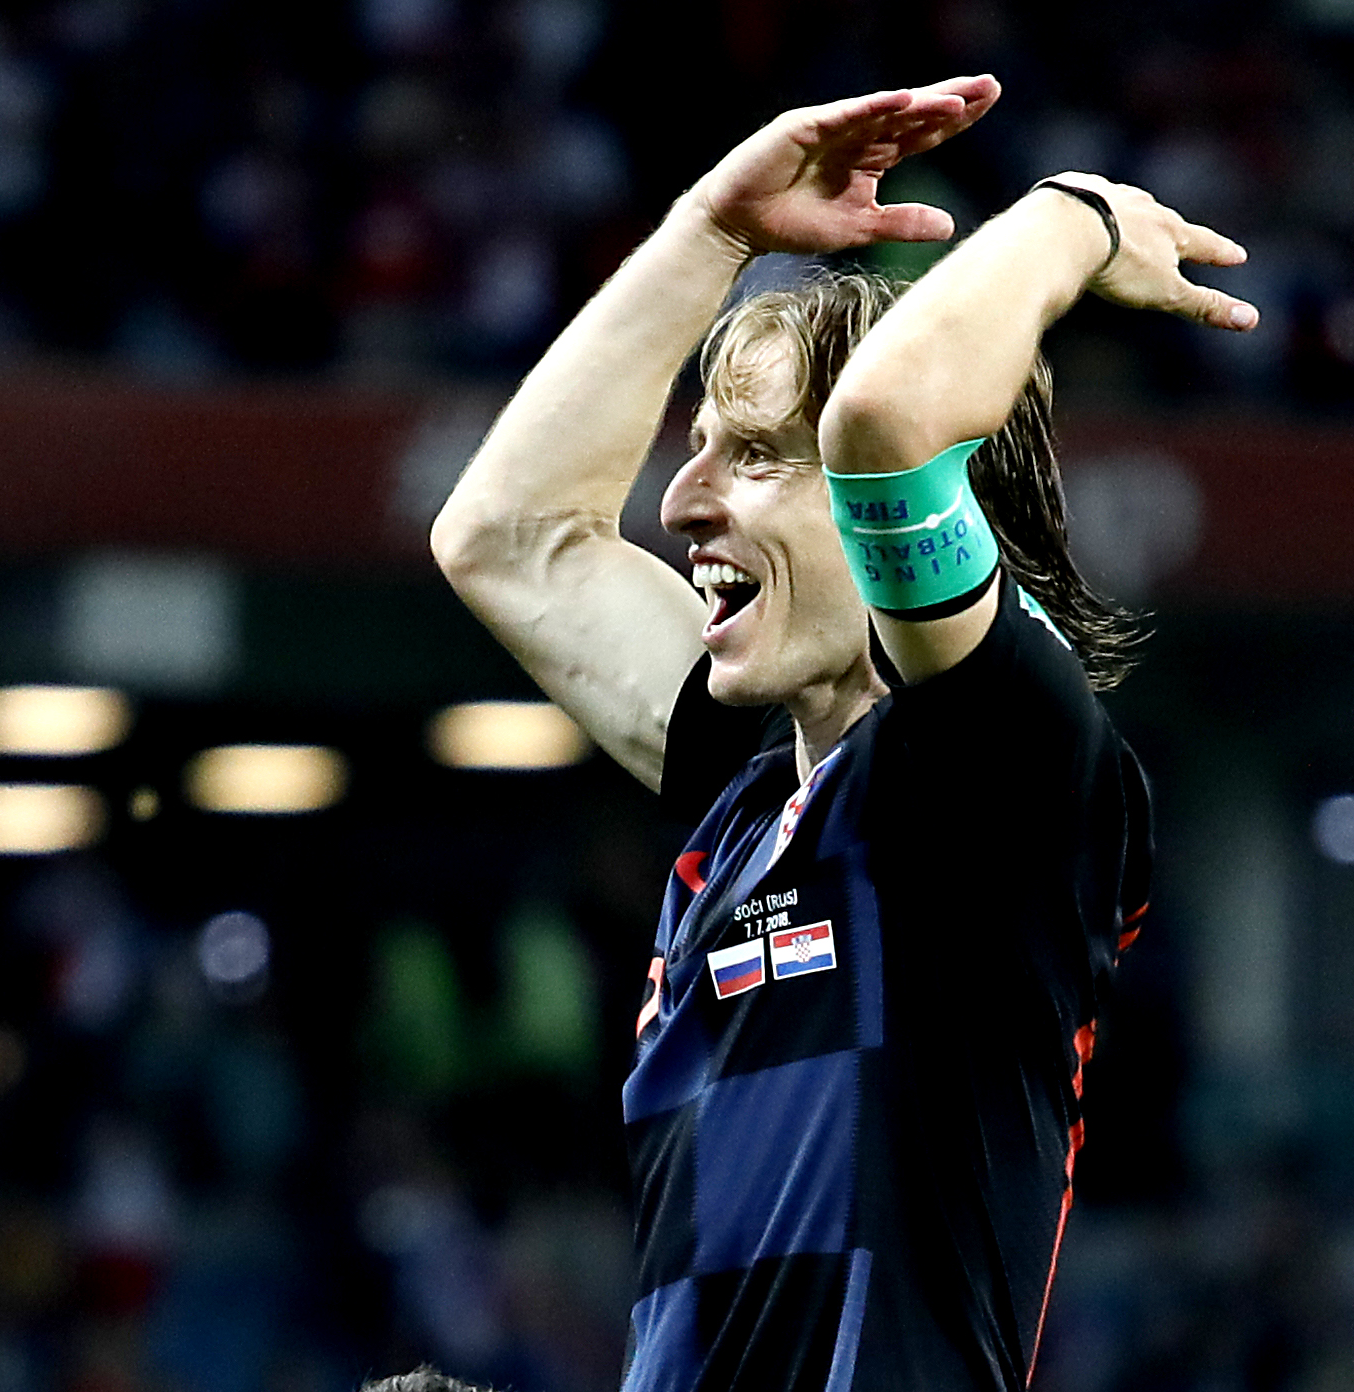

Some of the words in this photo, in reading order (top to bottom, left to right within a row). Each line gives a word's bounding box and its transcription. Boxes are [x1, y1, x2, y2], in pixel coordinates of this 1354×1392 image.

[846, 500, 909, 520] FIFA
[733, 899, 763, 921] SOČI
[766, 888, 798, 912] (RUS)
